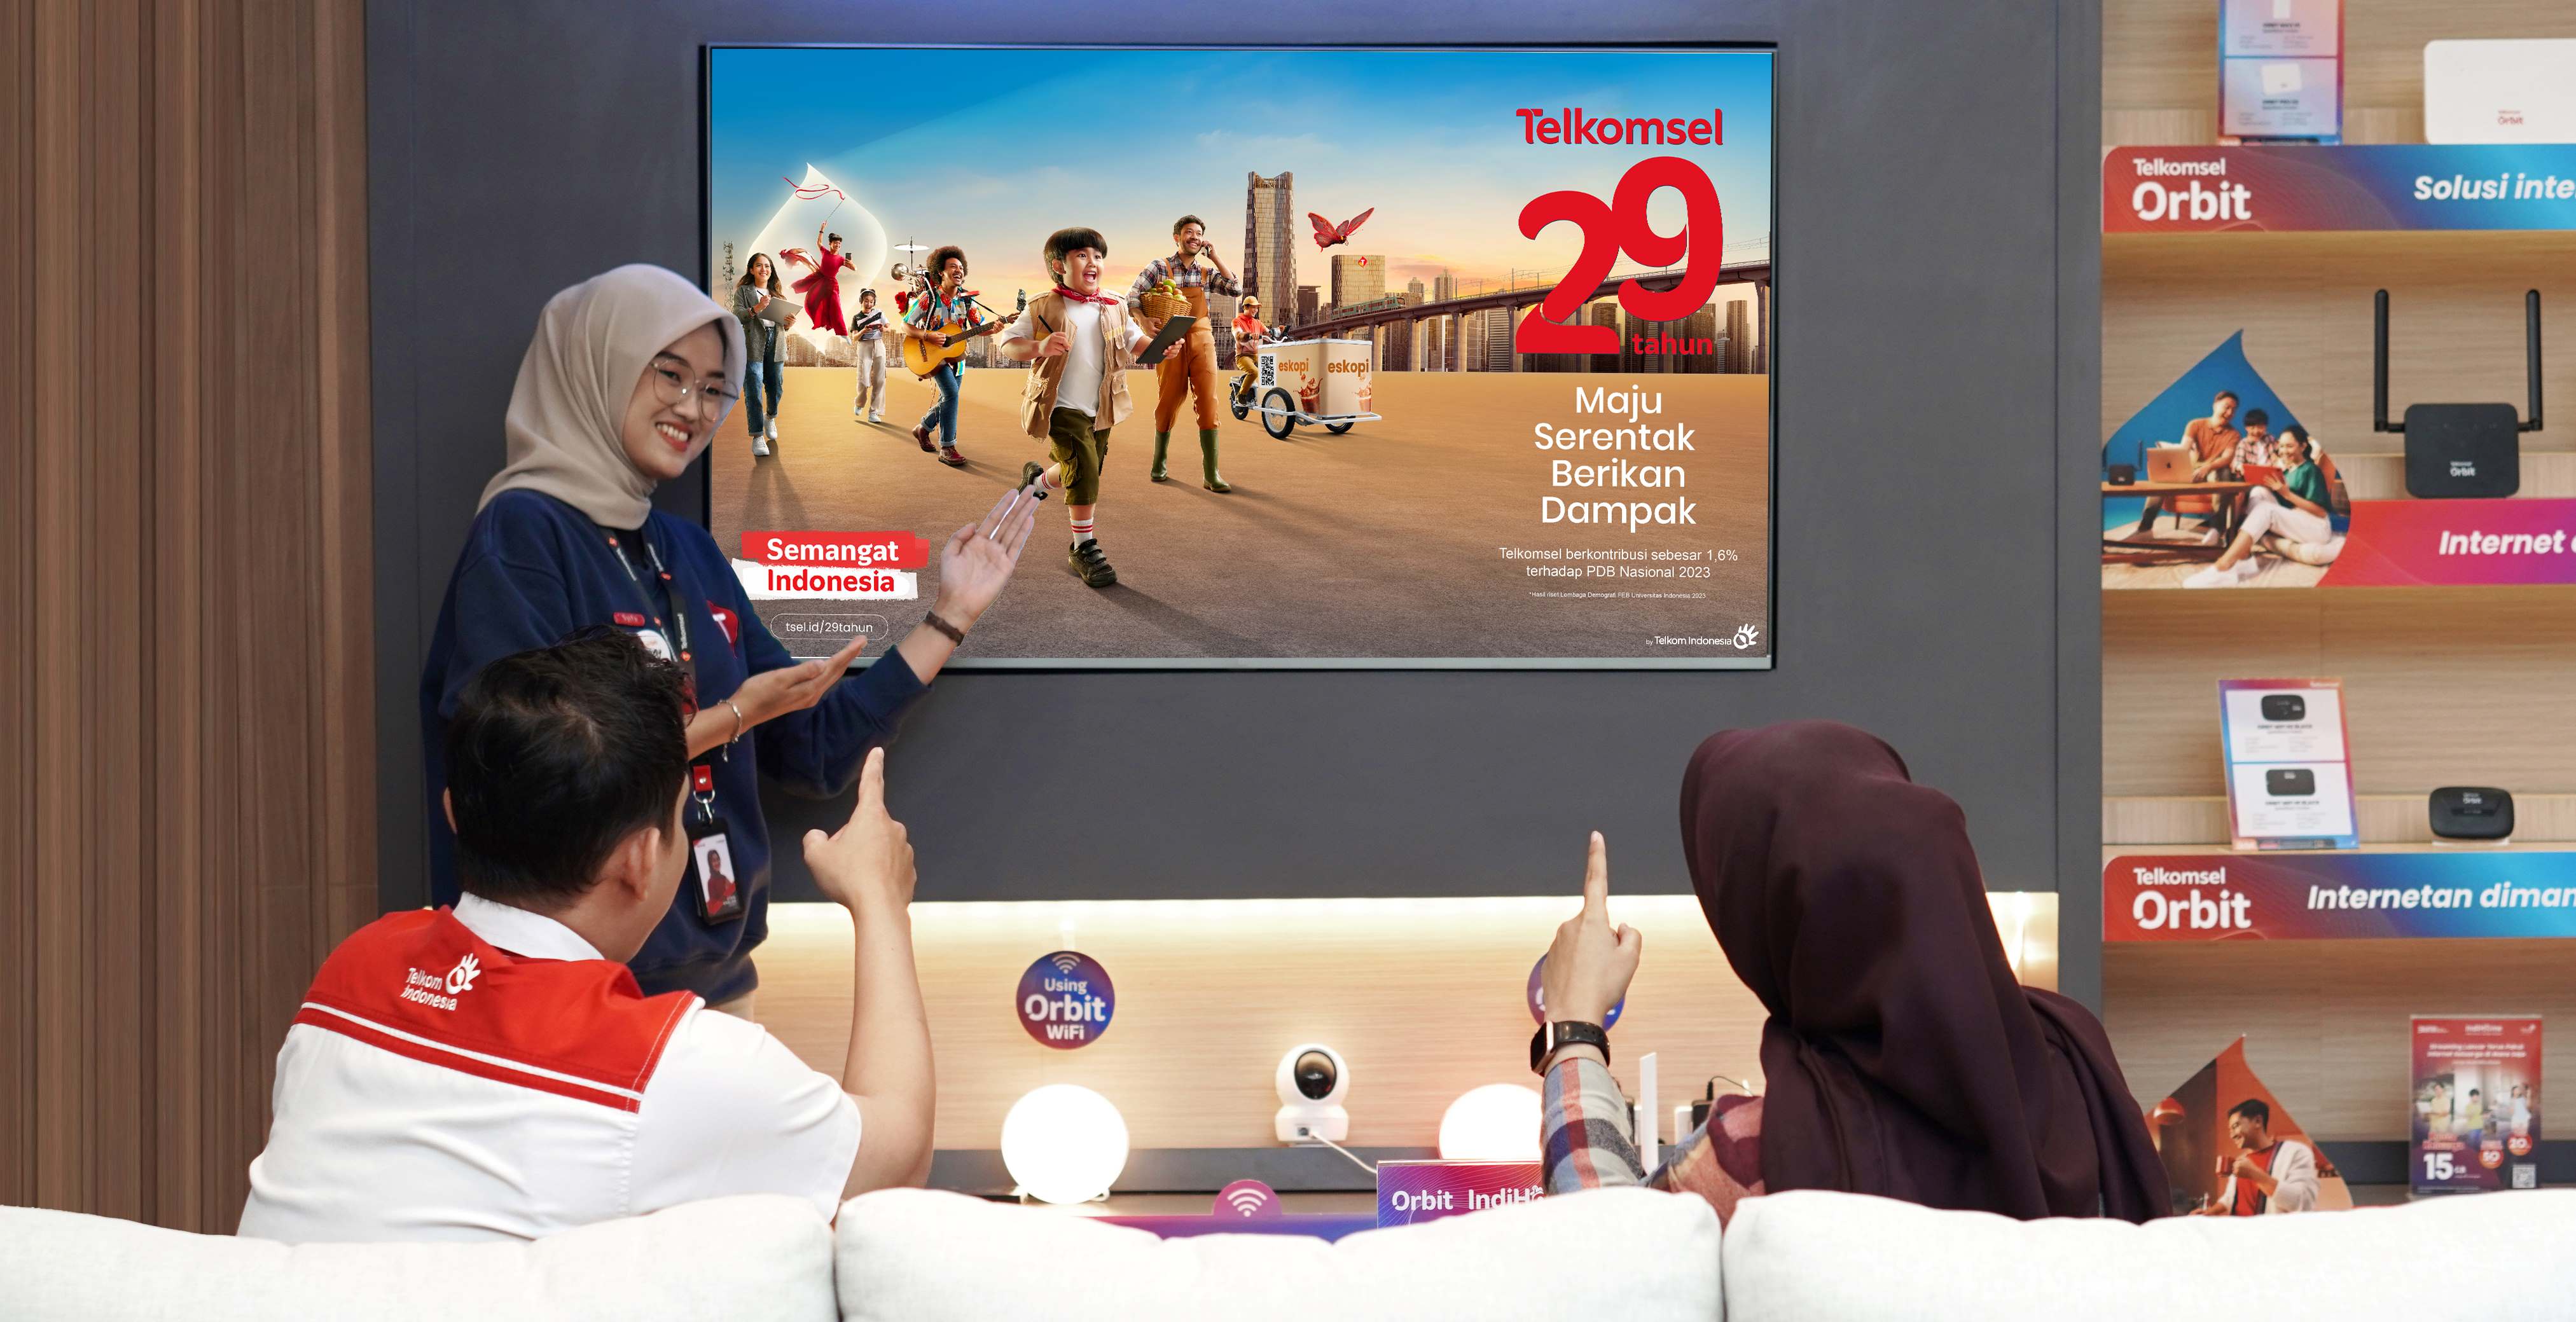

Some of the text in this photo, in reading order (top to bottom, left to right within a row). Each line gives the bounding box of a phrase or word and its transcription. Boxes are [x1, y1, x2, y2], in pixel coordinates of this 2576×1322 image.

[1516, 107, 1723, 145] Telkomsel
[2133, 158, 2226, 176] Telkomsel
[2414, 172, 2576, 200] Solusi inte
[2133, 181, 2252, 221] Orbit
[1516, 156, 1723, 354] 29
[1631, 331, 1713, 355] tahun
[1278, 358, 1309, 376] eskopi
[1327, 358, 1369, 377] eskopi
[1575, 384, 1662, 423] Maju
[1534, 422, 1696, 451] Serentak
[1551, 457, 1686, 488] Berikan
[1541, 496, 1697, 534] Dampak
[766, 538, 899, 566] Semangat
[2439, 529, 2566, 555] Internet
[1499, 547, 1738, 563] Telkomsel berkontribusi sebesar 1,6%
[767, 569, 895, 592] Indonesia
[1526, 565, 1711, 580] terhadap PDB Nasional 2023
[677, 612, 689, 650] Telkomsel
[785, 621, 874, 634] tsel.id/29tahun
[1654, 636, 1687, 645] Telkom
[1689, 636, 1732, 645] Indonesia
[2133, 867, 2226, 885] Telkomsel
[2308, 884, 2473, 909] Internetan
[2133, 890, 2252, 930] Orbit
[405, 967, 443, 990] Telkom
[1044, 978, 1088, 995] Using
[400, 984, 458, 1012] Indonesia
[1024, 994, 1106, 1022] Orbit
[1046, 1024, 1085, 1040] WiFi
[2423, 1152, 2454, 1181] 15
[1392, 1189, 1454, 1211] Orbit
